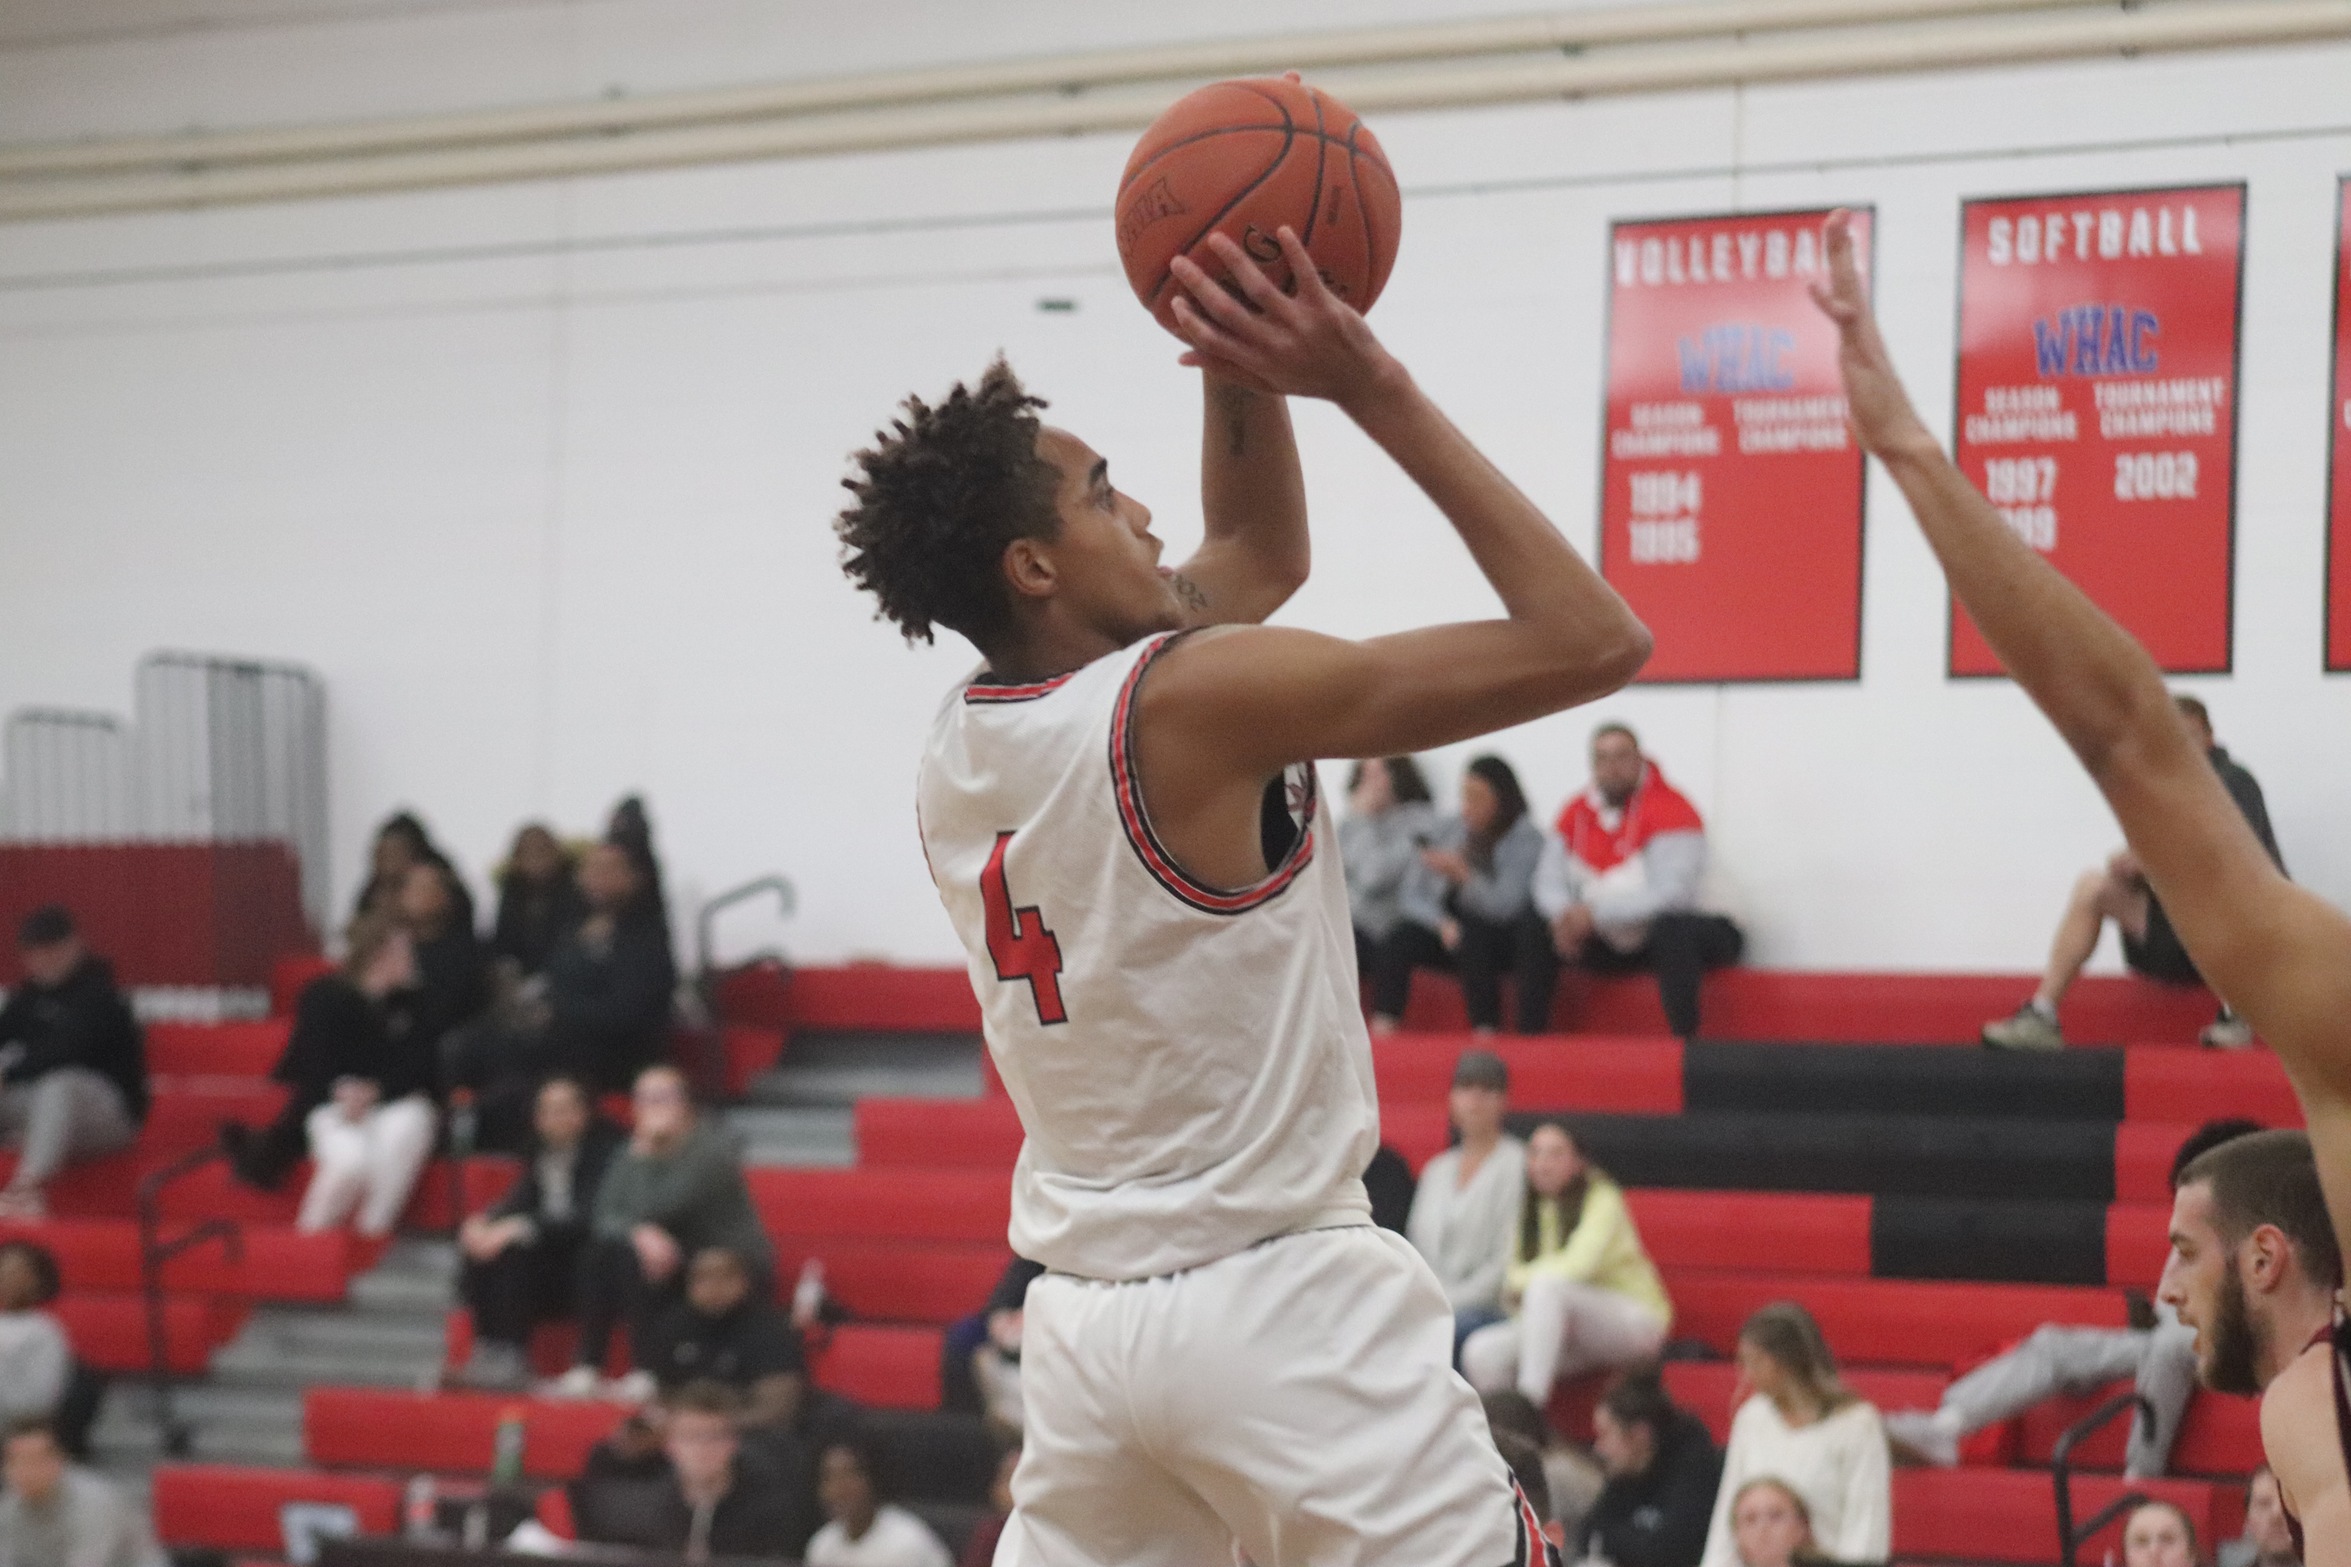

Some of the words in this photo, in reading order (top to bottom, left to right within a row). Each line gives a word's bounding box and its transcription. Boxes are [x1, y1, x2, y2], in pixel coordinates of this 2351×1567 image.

[1988, 206, 2202, 266] SOFTBALL
[1677, 322, 1795, 393] WHAC
[2034, 303, 2160, 378] WHAC
[1985, 386, 2060, 415] SEASON
[2093, 377, 2223, 410] TOURNAMENT
[1630, 402, 1705, 429] SEASON
[1965, 412, 2078, 443] CHAMPIONS
[2100, 406, 2215, 439] CHAMPIONS
[1612, 426, 1720, 460] CHAMPIONS
[1738, 424, 1847, 455] CHAMPIONS
[1986, 457, 2057, 504] 1997
[2114, 451, 2198, 501] 2002
[979, 830, 1068, 1025] 4
